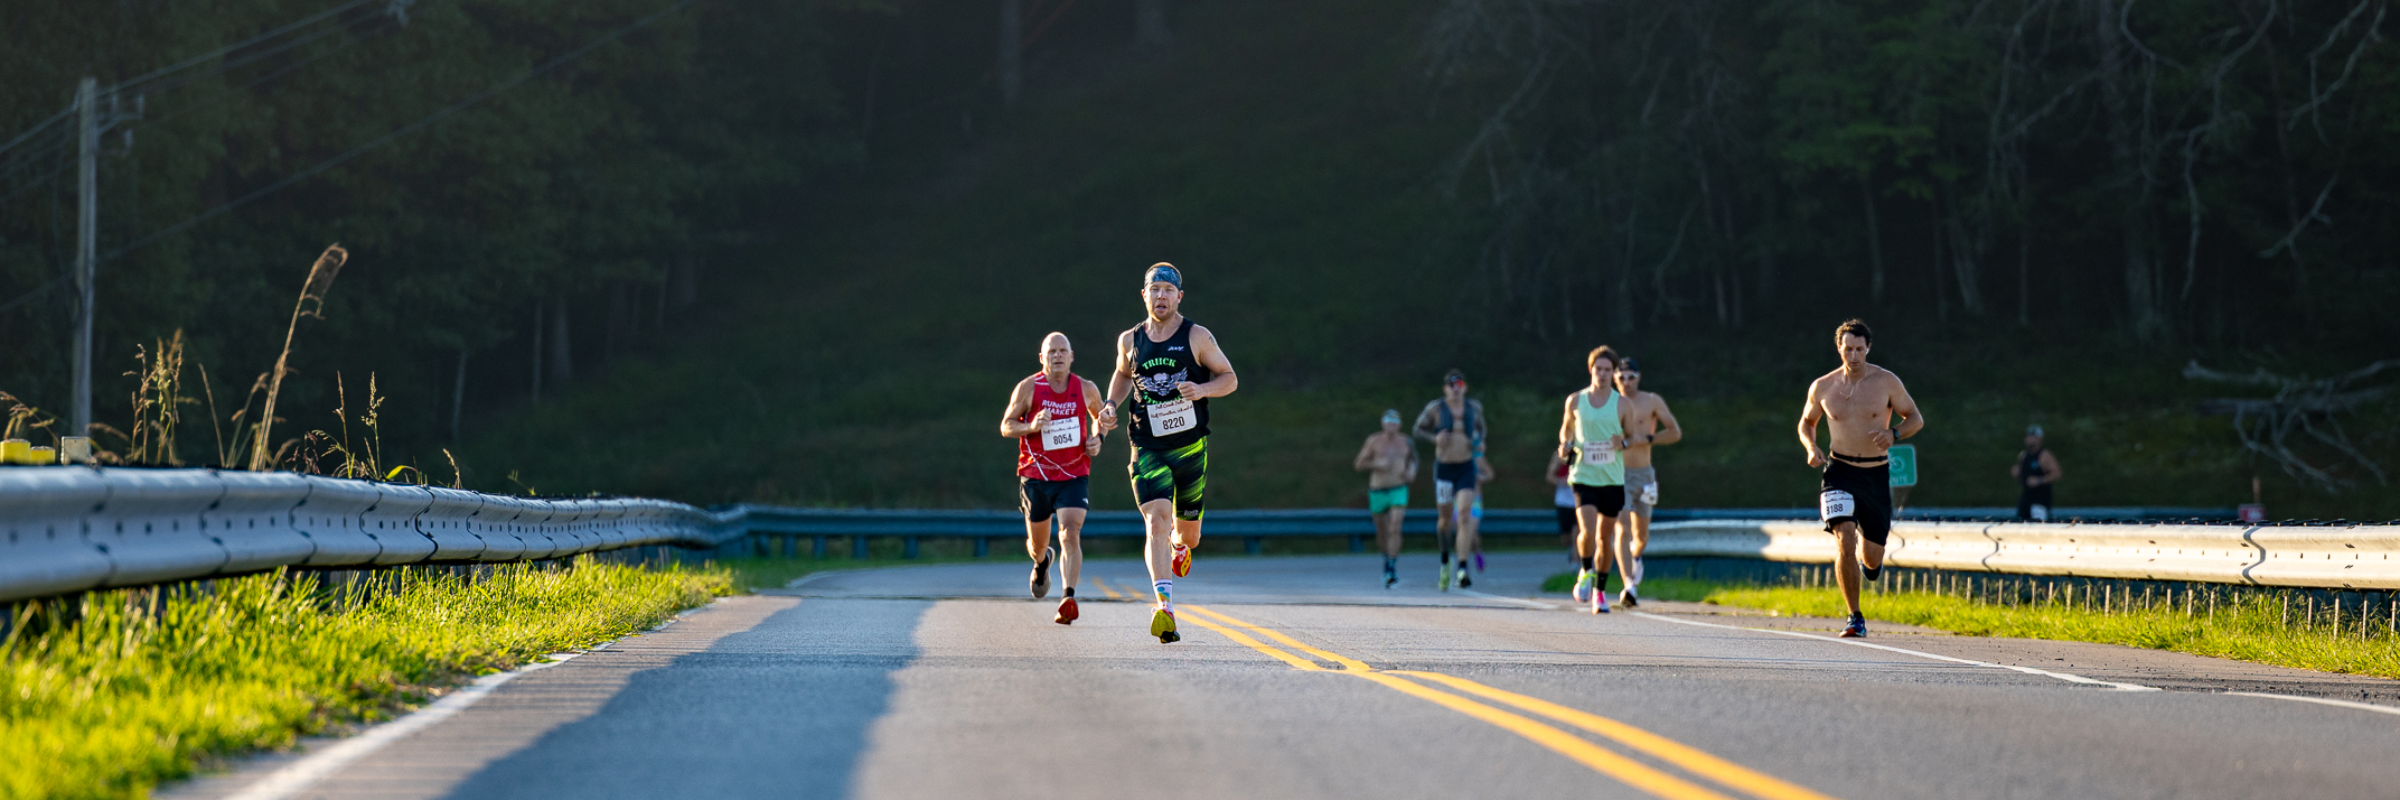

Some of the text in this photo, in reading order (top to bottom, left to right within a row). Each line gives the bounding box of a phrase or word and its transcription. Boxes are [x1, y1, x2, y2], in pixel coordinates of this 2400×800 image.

[1041, 399, 1077, 409] RUNNERS
[1162, 416, 1185, 430] 8220
[1052, 433, 1073, 445] 8054
